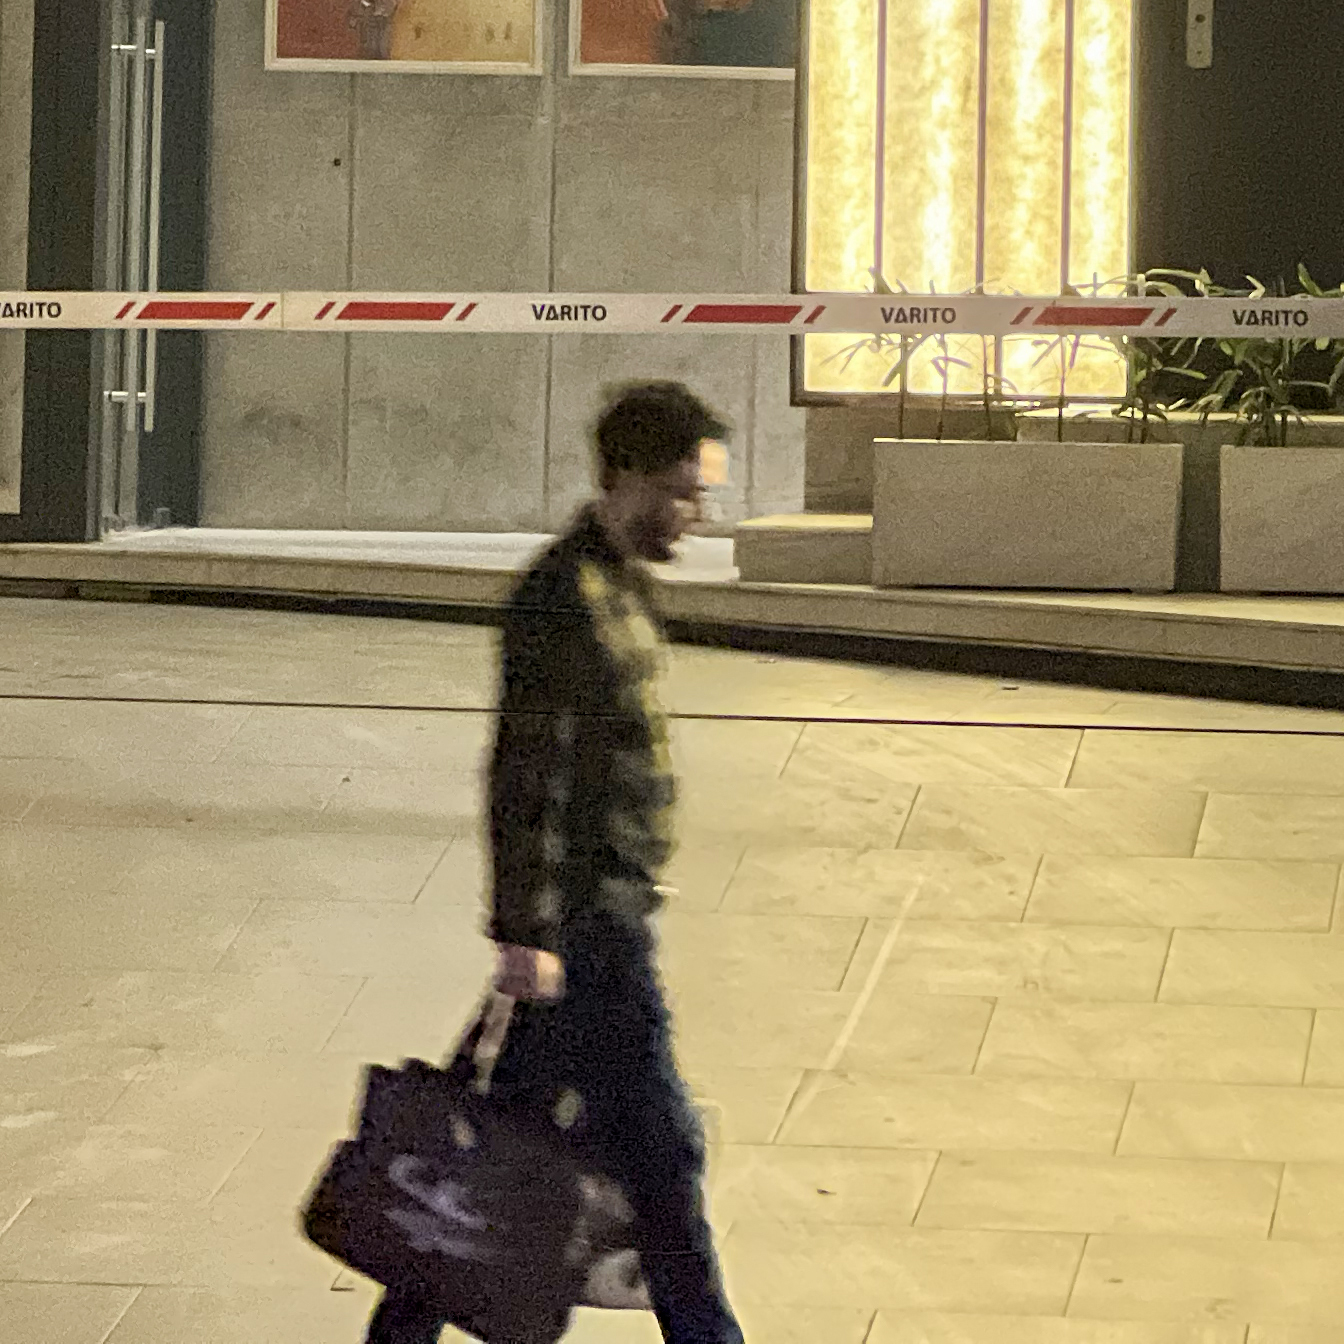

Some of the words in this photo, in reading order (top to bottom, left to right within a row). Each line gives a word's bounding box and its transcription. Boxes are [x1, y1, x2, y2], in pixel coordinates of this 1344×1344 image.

[531, 303, 607, 322] VARITO
[880, 306, 957, 325] VARITO
[1232, 309, 1310, 328] VARITO
